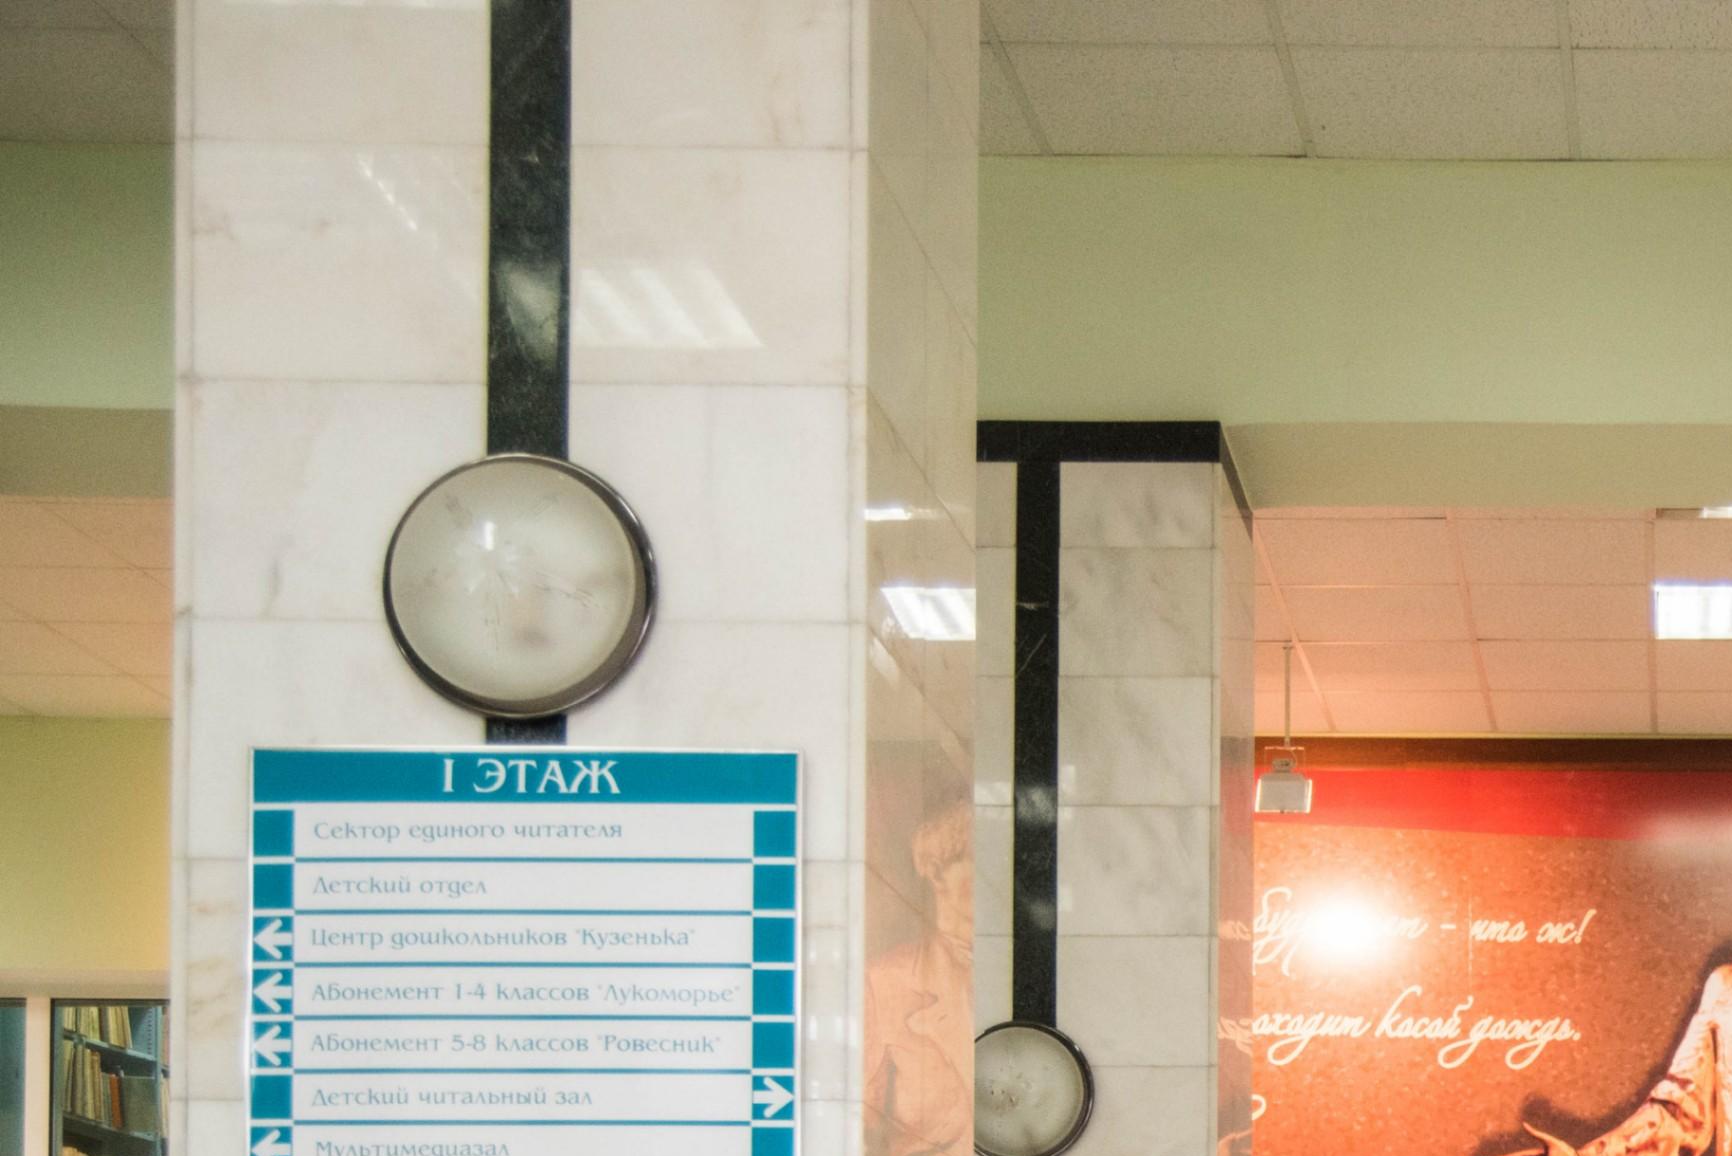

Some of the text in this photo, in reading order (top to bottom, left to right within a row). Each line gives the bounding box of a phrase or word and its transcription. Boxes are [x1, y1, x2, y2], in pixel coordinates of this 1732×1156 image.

[473, 758, 621, 794] ЭТАЖ
[313, 821, 623, 843] Сектор единого читателя
[312, 875, 487, 898] Детский отдел
[311, 927, 695, 951] Центр дошкольников "Кузенька"
[311, 982, 442, 1001] Абонемент
[496, 983, 590, 1001] классов
[1375, 985, 1474, 1041] косой
[1437, 1014, 1583, 1070] дождь.
[311, 1034, 440, 1052] Абонемент
[451, 1034, 487, 1052] 5-8
[495, 1034, 590, 1052] классов
[311, 1087, 593, 1107] Детский читальный зал
